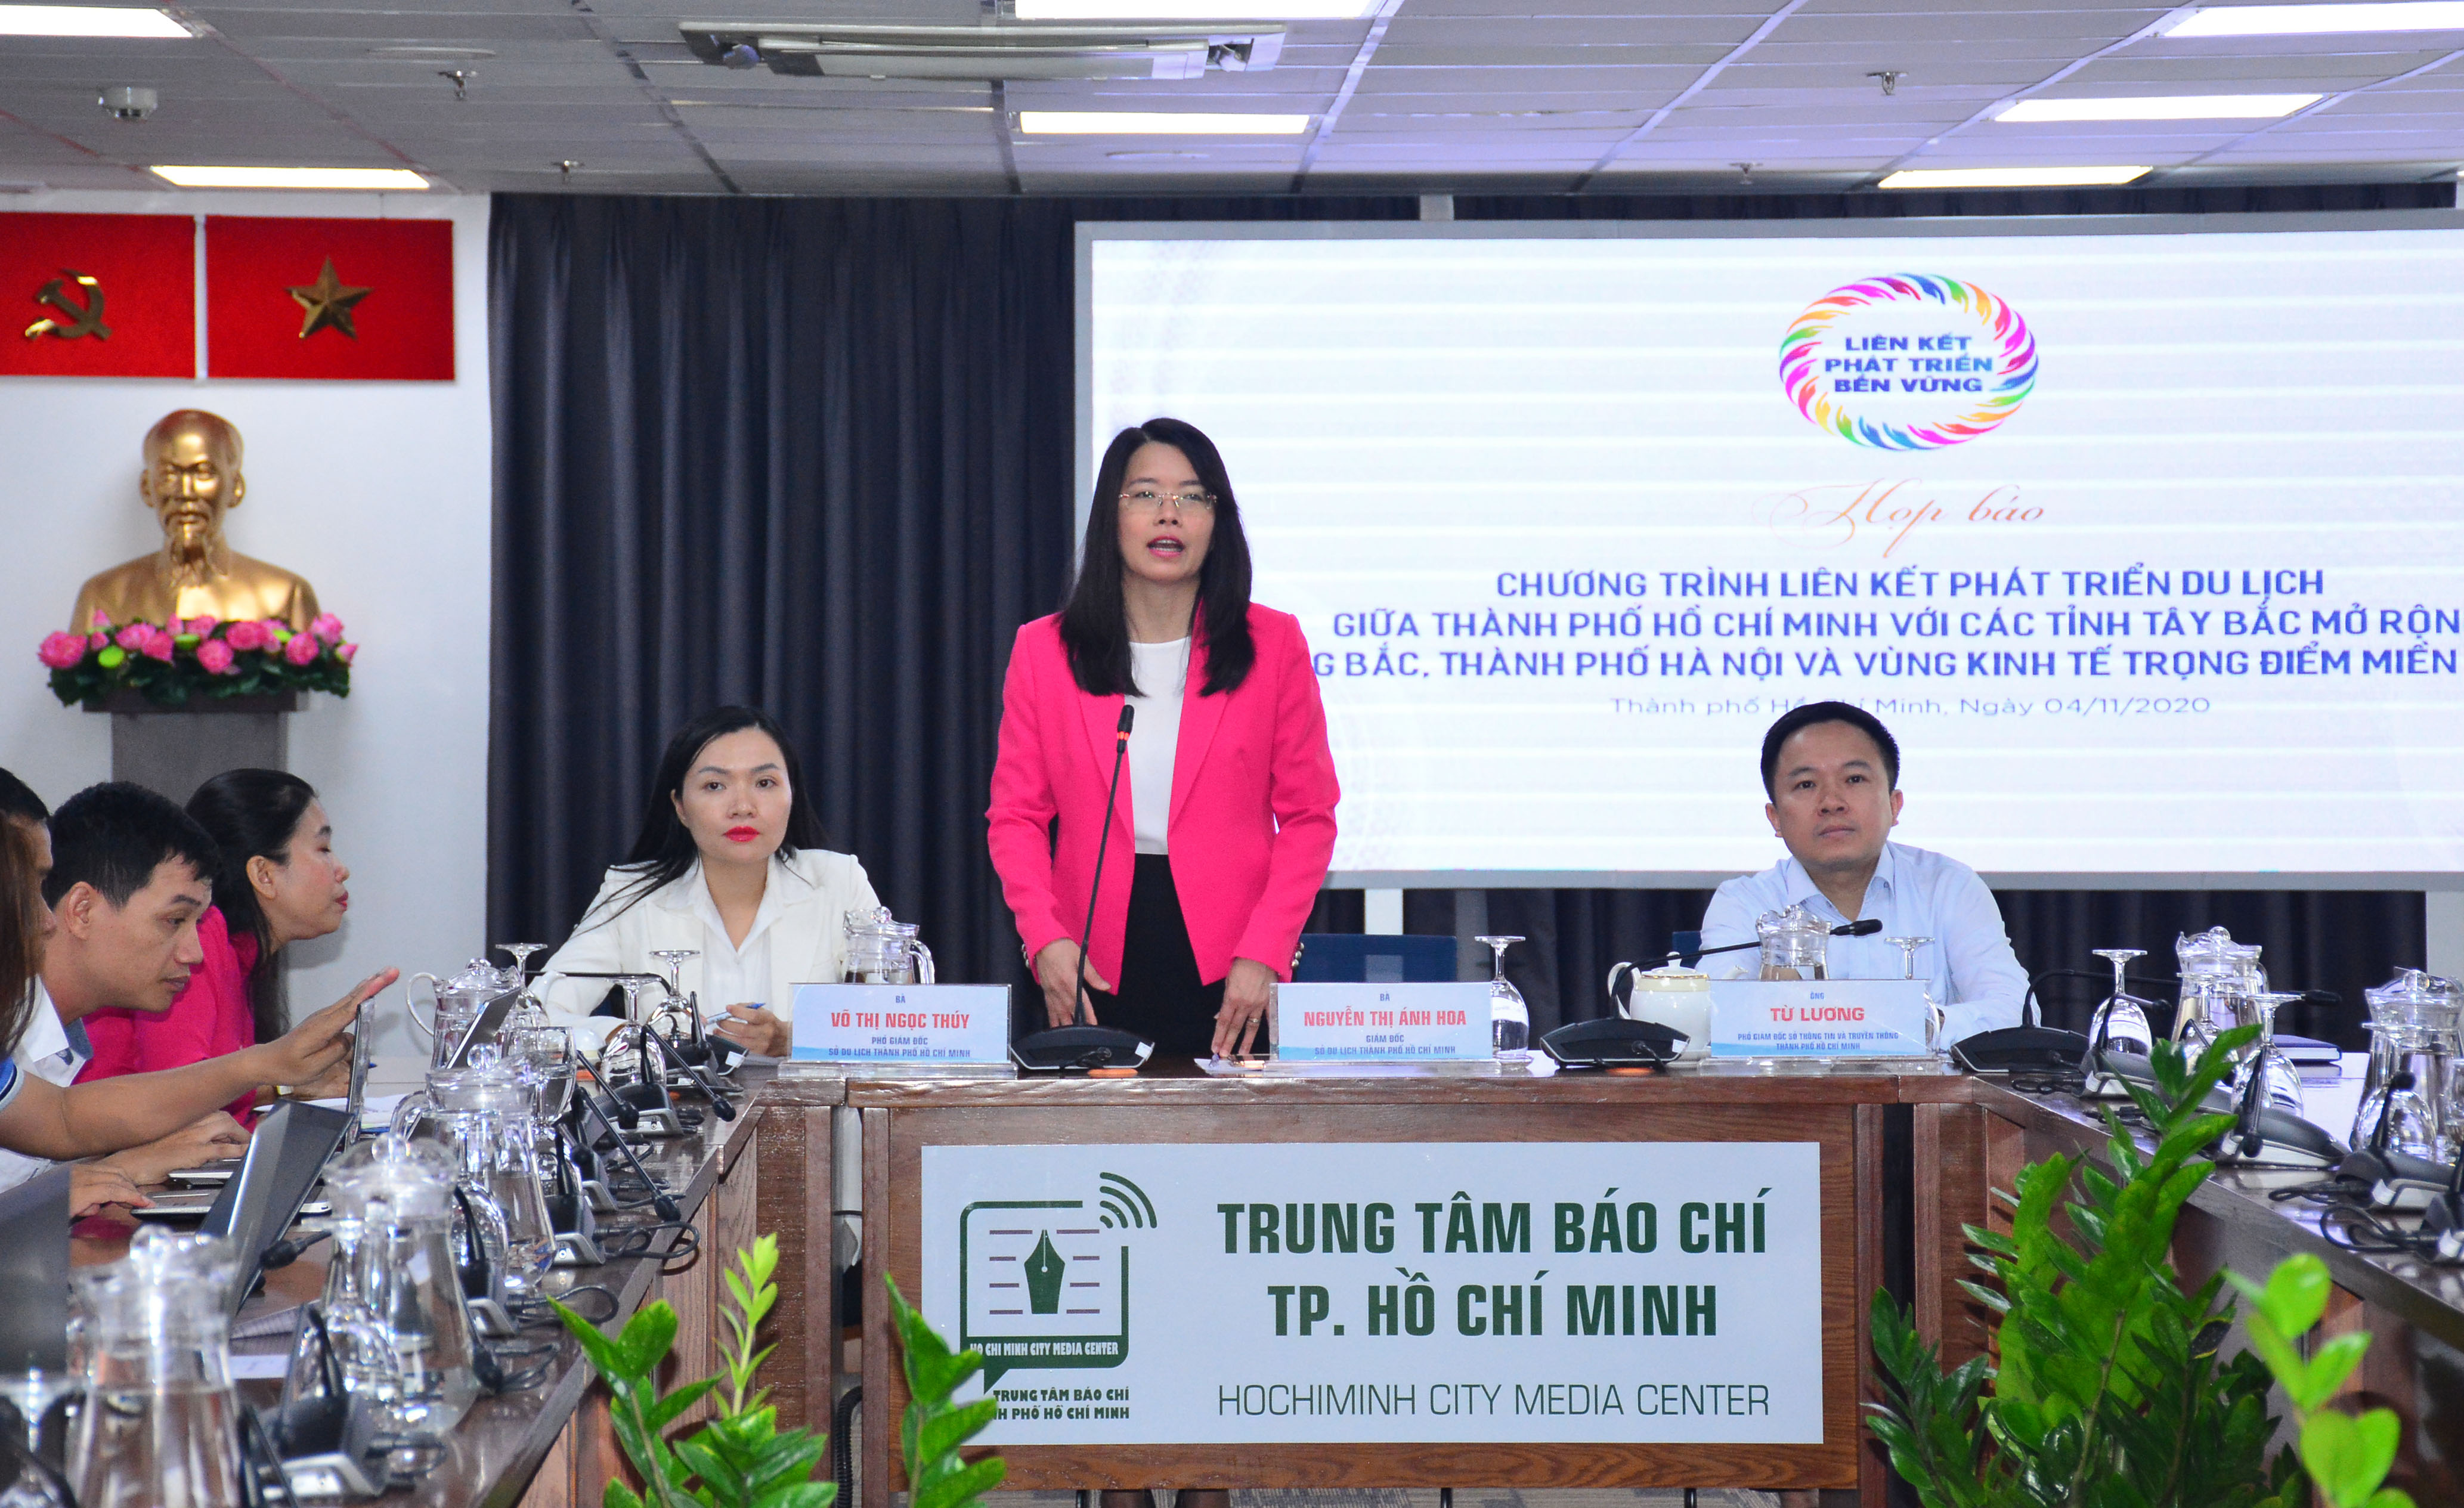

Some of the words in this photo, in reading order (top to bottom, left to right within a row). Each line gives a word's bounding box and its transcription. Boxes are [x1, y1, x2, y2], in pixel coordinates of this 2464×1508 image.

[1845, 333, 1909, 351] LIÊN
[1918, 332, 1973, 351] KẾT
[1824, 354, 1899, 373] PHÁT
[1908, 352, 1994, 373] TRIỂN
[1968, 484, 2044, 522] báo
[1496, 569, 1647, 597] CHƯƠNG
[1660, 566, 1769, 597] TRÌNH
[1780, 567, 1858, 597] LIÊN
[1871, 563, 1940, 597] KẾT
[1950, 565, 2051, 596] PHÁT
[2061, 562, 2171, 596] TRIỂN
[2182, 570, 2231, 596] DU
[2242, 569, 2324, 602] LỊCH
[1333, 608, 1420, 637] GIỮA
[1432, 607, 1557, 637] THÀNH
[1568, 604, 1644, 637] PHỐ
[1653, 603, 1702, 637] HỒ
[1713, 605, 1773, 637] CHÍ
[1783, 612, 1878, 636] MINH
[1890, 605, 1949, 636] VỚI
[1960, 606, 2035, 636] CÁC
[2046, 603, 2131, 636] TỈNH
[2143, 604, 2212, 636] TÂY
[2224, 597, 2301, 636] BẮC
[2312, 602, 2368, 634] MỞ
[2380, 603, 2460, 639] RỘN
[1345, 642, 1429, 678] BẮC,
[1440, 646, 1565, 677] THÀNH
[1575, 644, 1649, 676] PHỐ
[1660, 646, 1713, 676] HÀ
[1722, 646, 1783, 681] NỘI
[1794, 646, 1842, 676] VÀ
[1853, 645, 1957, 676] VÙNG
[1967, 651, 2056, 676] KINH
[2066, 645, 2112, 676] TẾ
[2122, 650, 2249, 681] TRỌNG
[2259, 640, 2351, 675] ĐIỂM
[2362, 640, 2457, 674] MIỀN
[1611, 696, 1695, 714] Thành
[1707, 695, 1760, 716] phố
[1876, 697, 1948, 716] Minh,
[1960, 696, 2035, 718] Ngày
[2045, 696, 2211, 717] 04/11/2020
[895, 994, 906, 1004] BÀ
[1380, 992, 1391, 1002] BÀ
[1810, 992, 1825, 1000] ÔNG
[831, 1009, 851, 1028] VÕ
[856, 1012, 880, 1030] THỊ
[886, 1013, 927, 1031] NGỌC
[932, 1010, 970, 1029] THÚY
[1304, 1005, 1365, 1027] NGUYỄN
[1370, 1011, 1394, 1029] THỊ
[1399, 1007, 1431, 1026] ÁNH
[1437, 1010, 1467, 1026] HOA
[1770, 1004, 1794, 1021] TỪ
[1800, 1007, 1865, 1021] LƯƠNG
[871, 1035, 887, 1045] PHÓ
[889, 1035, 911, 1045] GIÁM
[912, 1035, 928, 1045] ĐỐC
[1366, 1033, 1387, 1043] GIÁM
[1389, 1032, 1405, 1043] ĐỐC
[1217, 1203, 1395, 1254] TRUNG
[1414, 1191, 1531, 1253] TÂM
[1554, 1187, 1658, 1253] BÁO
[1679, 1187, 1772, 1253] CHÍ
[1267, 1286, 1345, 1336] TP.
[1368, 1267, 1435, 1336] HỒ
[1457, 1270, 1550, 1336] CHÍ
[1567, 1285, 1717, 1336] MINH
[985, 1343, 1002, 1357] CHI
[1003, 1342, 1028, 1356] MINH
[1029, 1342, 1051, 1356] CITY
[1053, 1342, 1083, 1356] MEDIA
[1084, 1342, 1119, 1355] CENTER
[993, 1389, 1038, 1402] TRUNG
[1040, 1386, 1070, 1401] TÂM
[1073, 1386, 1102, 1401] BÁO
[1106, 1386, 1129, 1401] CHÍ
[1218, 1383, 1416, 1416] HOCHIMINH
[1430, 1384, 1502, 1416] CITY
[1515, 1384, 1625, 1416] MEDIA
[1637, 1384, 1769, 1416] CENTER
[1012, 1404, 1041, 1420] PHỐ
[1044, 1404, 1063, 1420] HỒ
[1067, 1404, 1090, 1419] CHÍ
[1094, 1407, 1130, 1419] MINH
